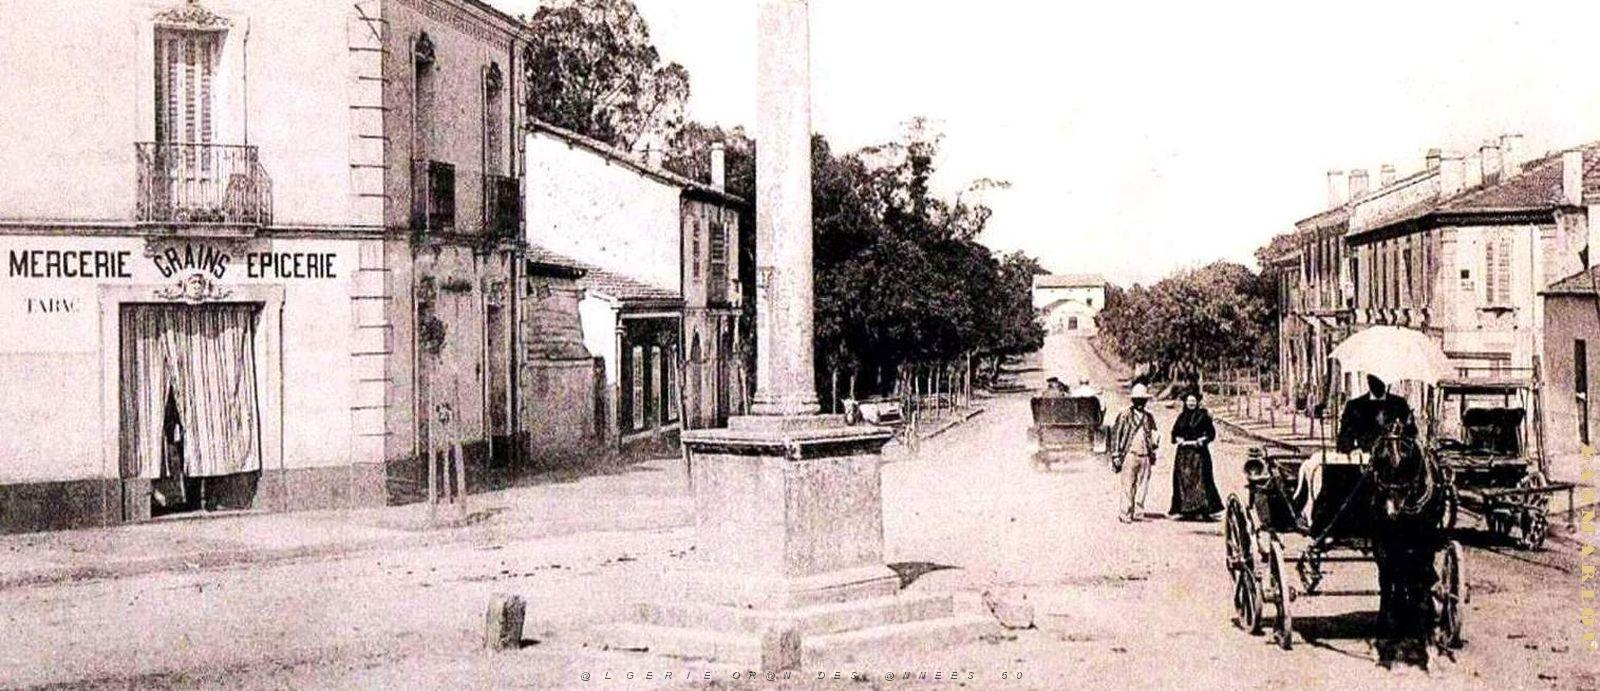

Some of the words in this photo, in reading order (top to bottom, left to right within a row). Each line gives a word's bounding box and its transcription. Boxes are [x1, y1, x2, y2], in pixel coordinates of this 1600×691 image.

[9, 250, 131, 278] MERCERIE
[154, 243, 231, 279] GRAINS
[247, 252, 337, 279] EPICERIE
[25, 298, 80, 314] TABAC
